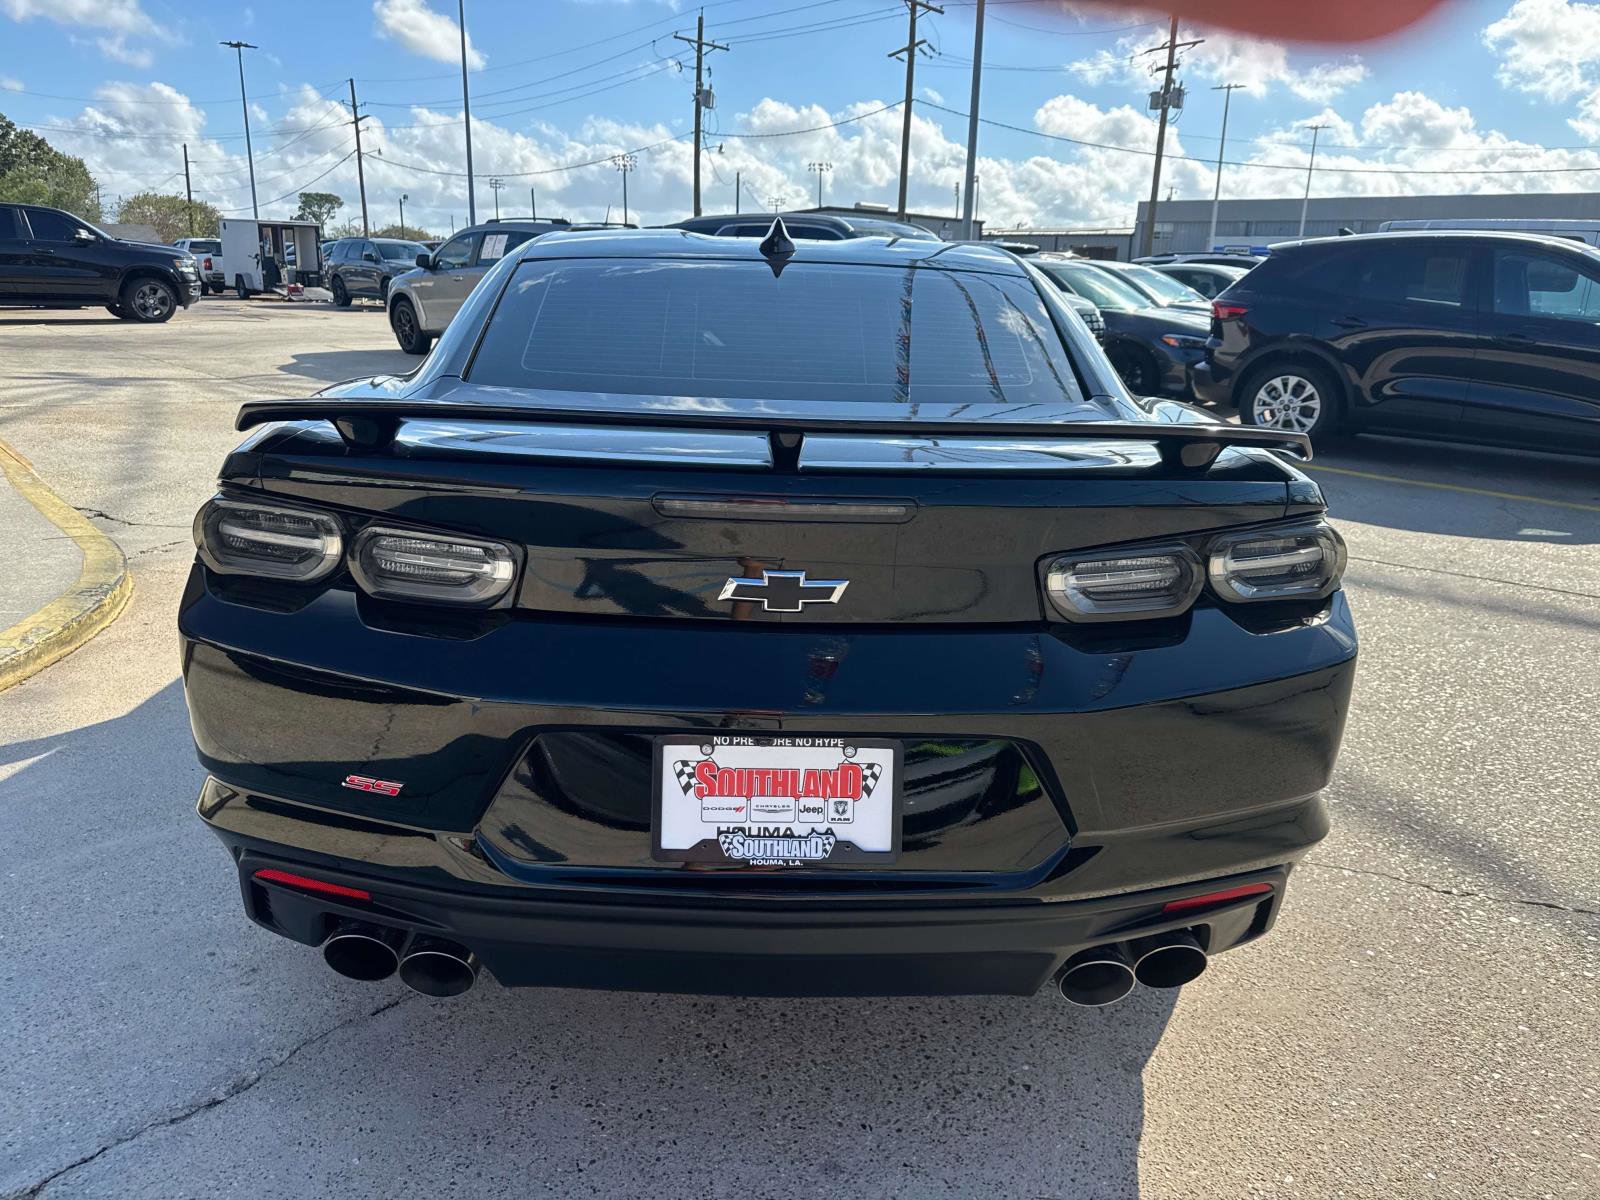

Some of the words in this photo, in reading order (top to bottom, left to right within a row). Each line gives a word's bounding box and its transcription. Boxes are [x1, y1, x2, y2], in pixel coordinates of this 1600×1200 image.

[713, 736, 729, 745] NO
[795, 738, 811, 747] NO
[815, 738, 844, 747] HYPE
[341, 775, 404, 796] SS
[799, 804, 824, 815] Jeep
